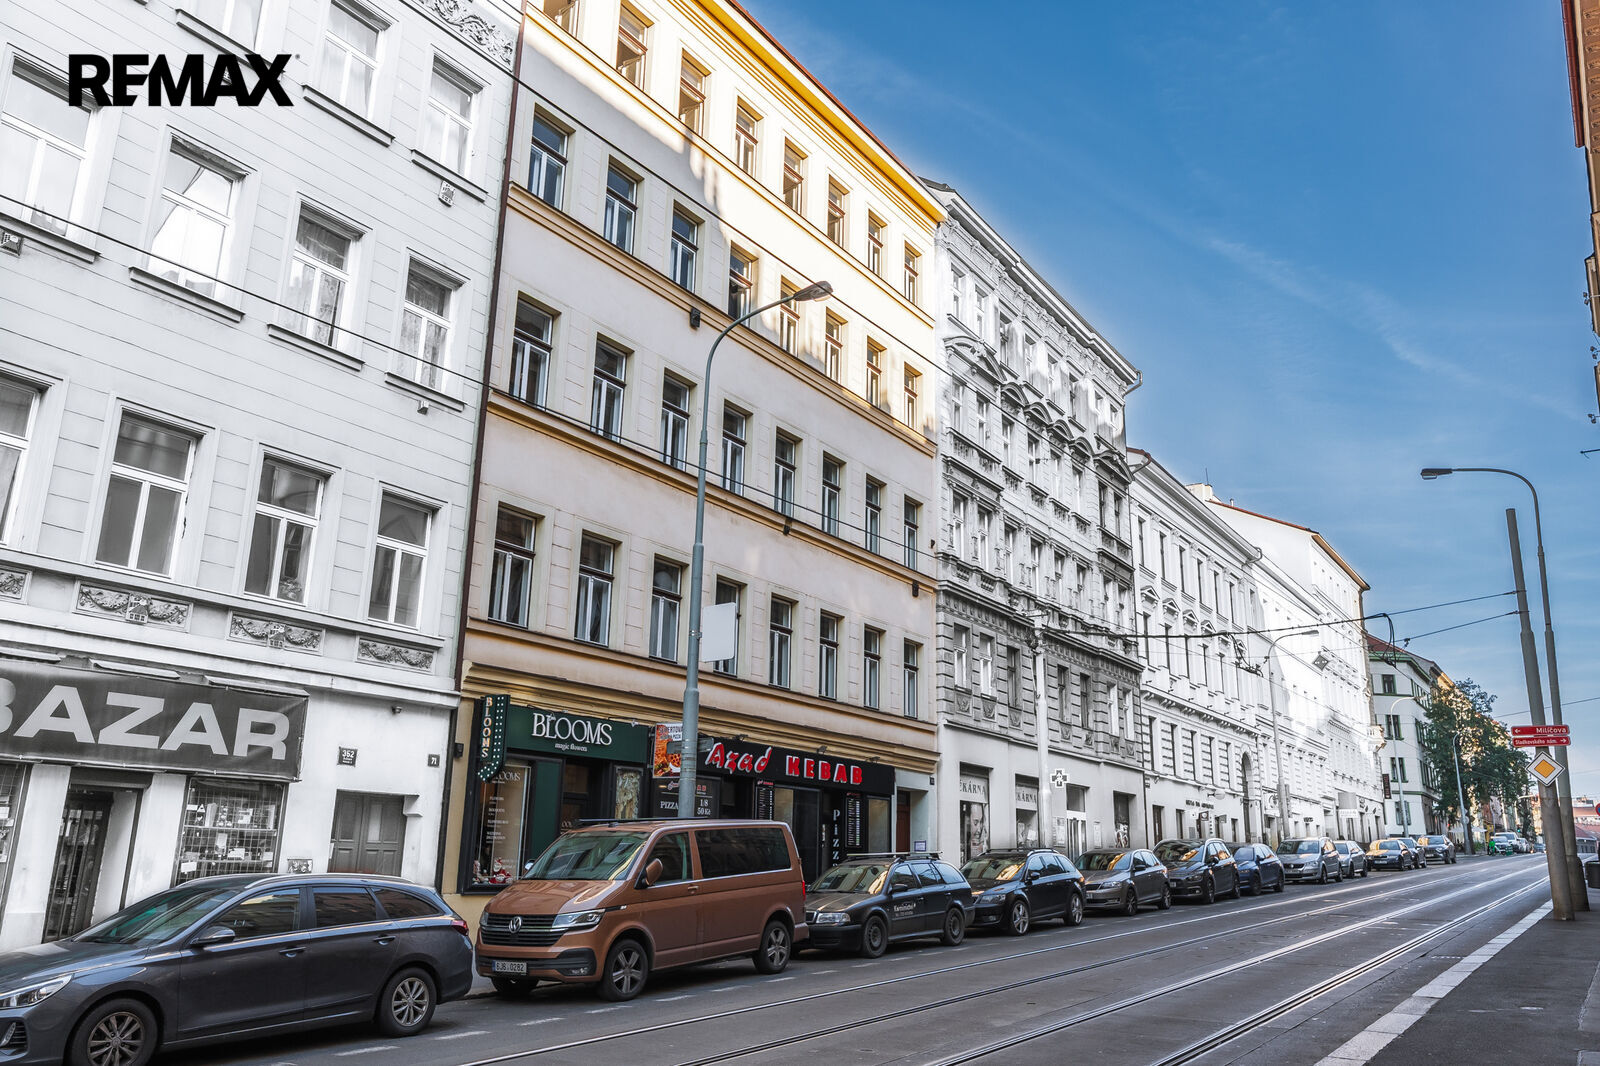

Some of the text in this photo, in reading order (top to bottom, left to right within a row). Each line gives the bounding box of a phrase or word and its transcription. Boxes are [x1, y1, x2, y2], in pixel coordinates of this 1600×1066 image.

[481, 696, 493, 758] BLOOMS
[531, 712, 613, 746] BLOOMS
[342, 749, 355, 759] 352
[704, 742, 864, 786] Azad KEBAB
[697, 807, 705, 815] 50
